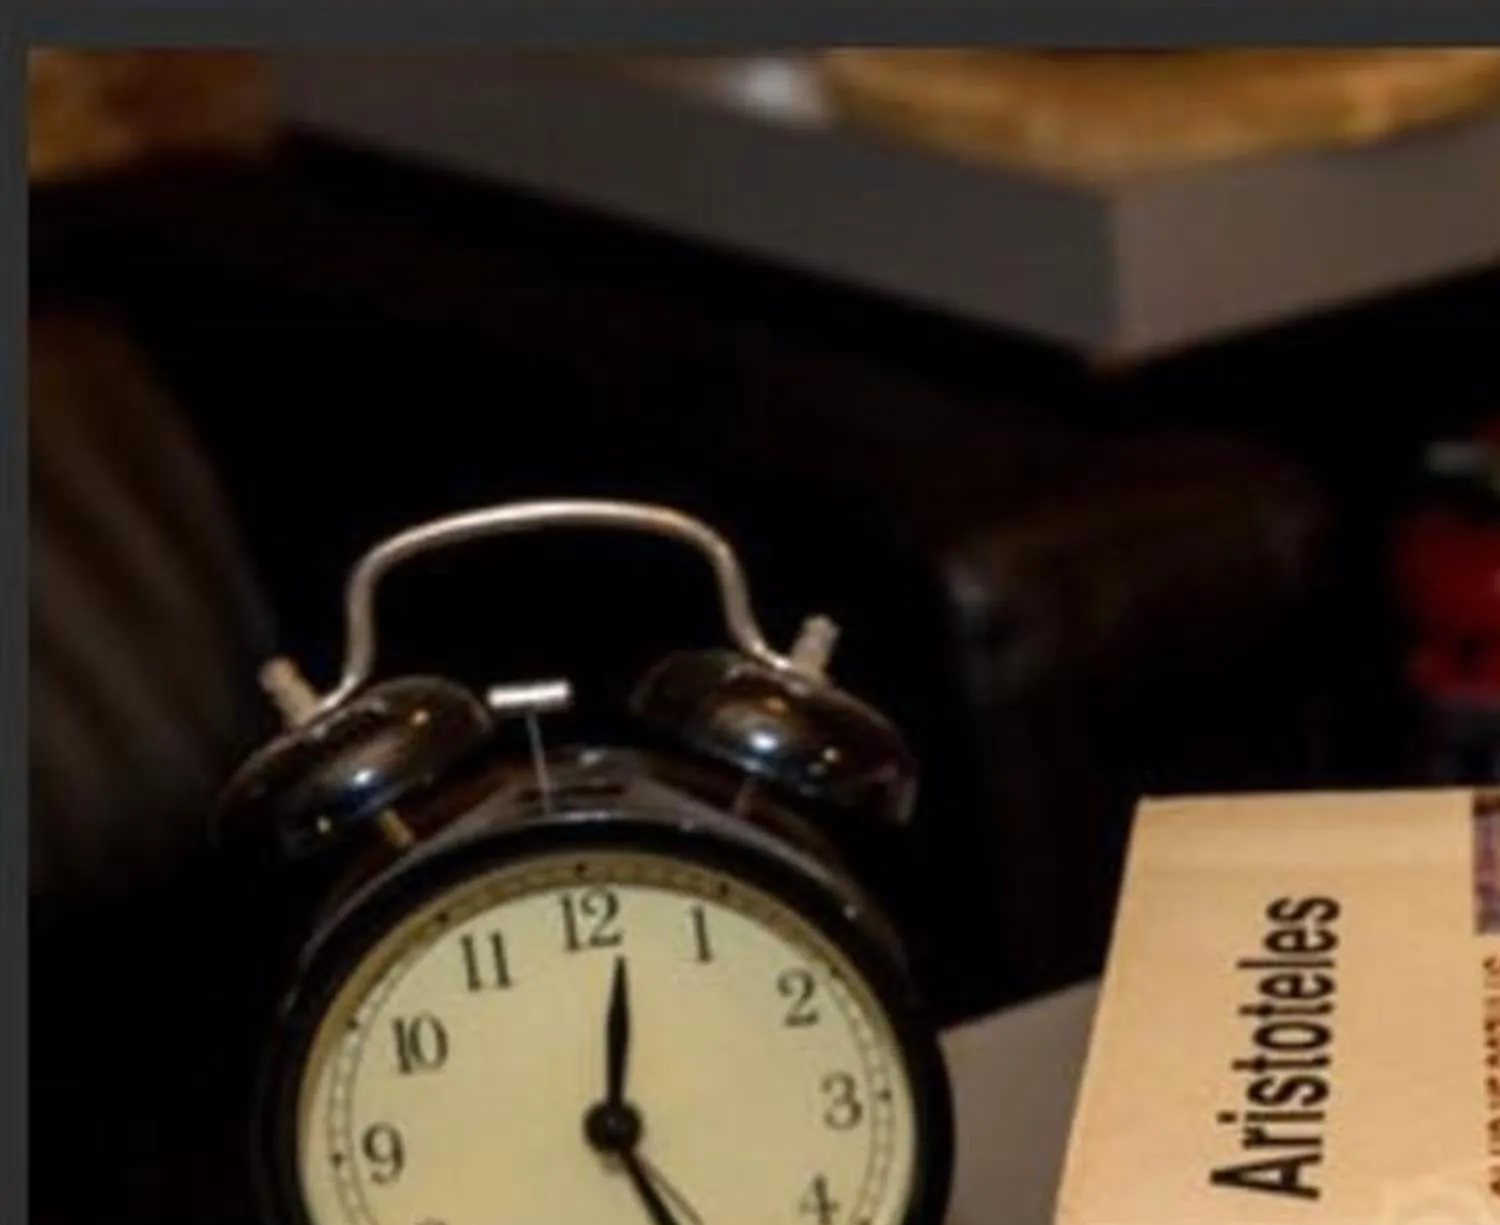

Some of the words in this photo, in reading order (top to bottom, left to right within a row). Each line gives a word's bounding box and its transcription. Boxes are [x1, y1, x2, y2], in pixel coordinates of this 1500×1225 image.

[557, 886, 625, 953] 12
[688, 906, 715, 964] 1
[457, 929, 514, 992] 11
[775, 966, 822, 1028] 2
[391, 1012, 450, 1075] 10
[1209, 896, 1341, 1200] Aristoteles
[821, 1072, 865, 1132] 3
[360, 1122, 407, 1185] 9
